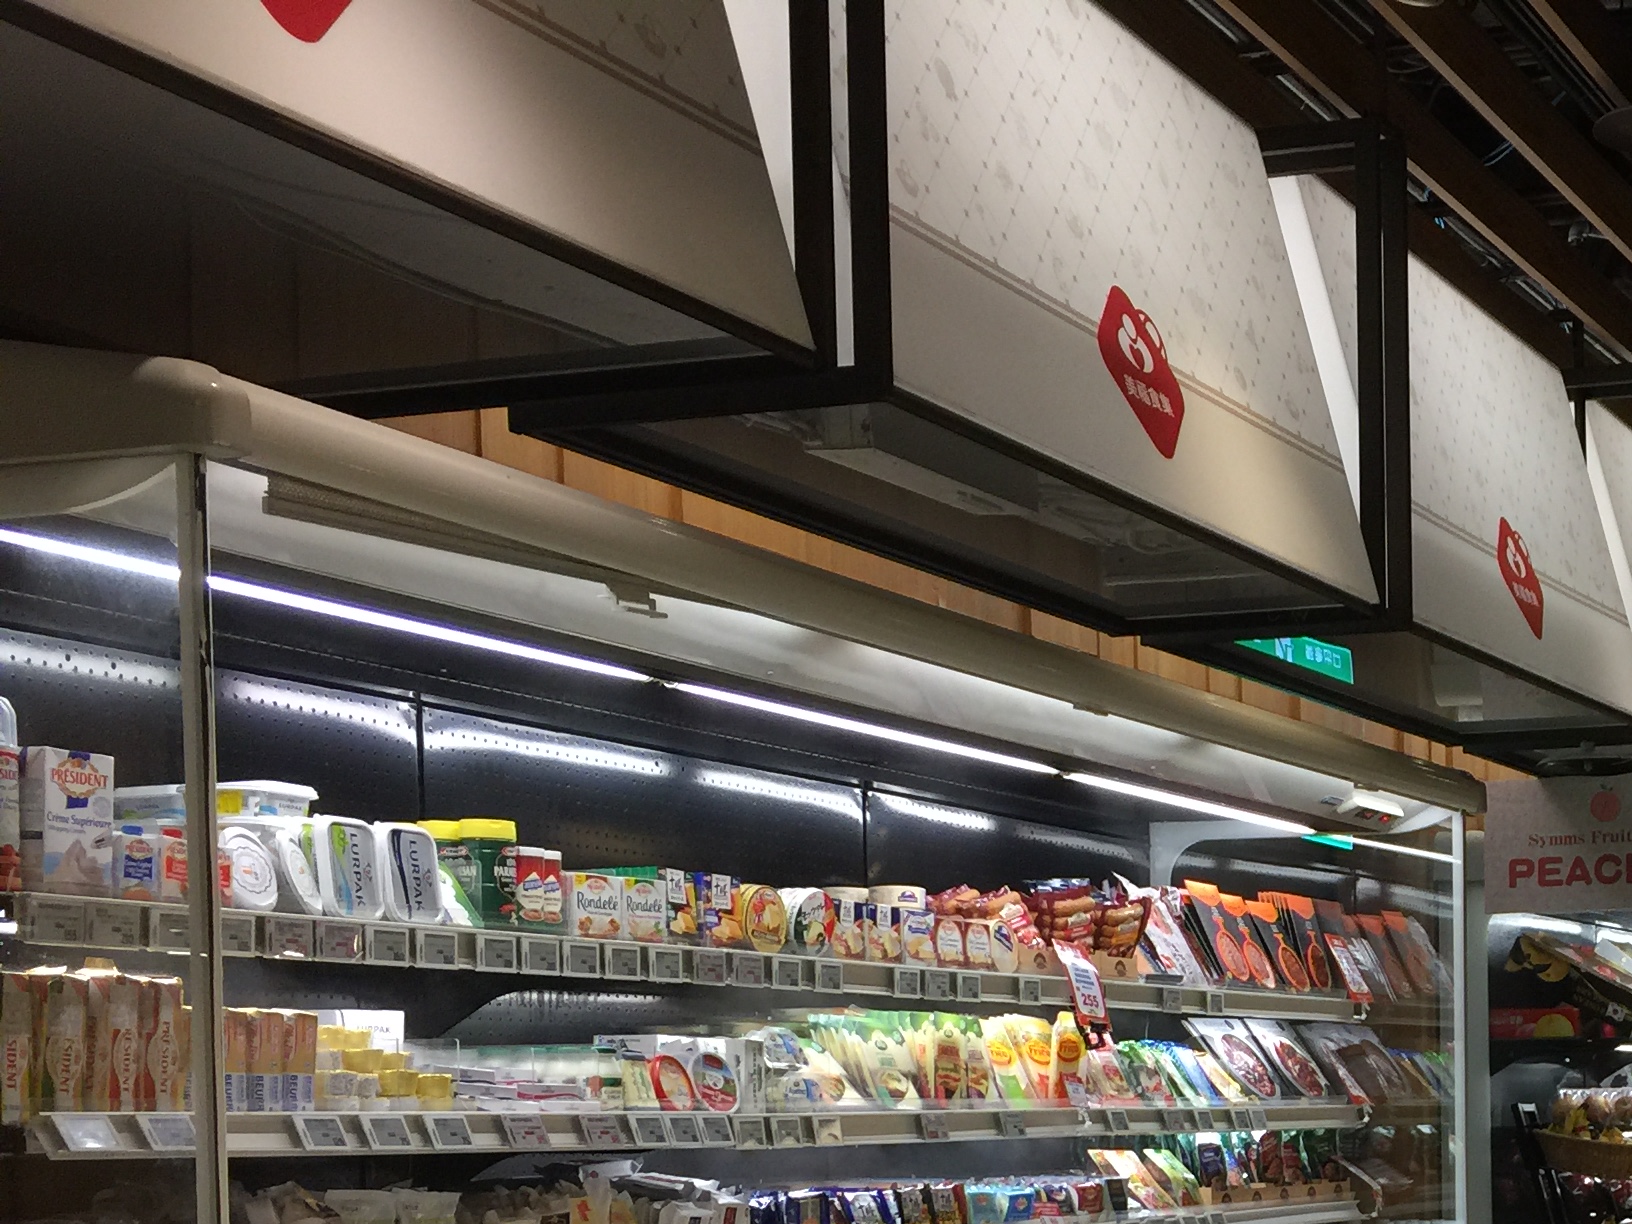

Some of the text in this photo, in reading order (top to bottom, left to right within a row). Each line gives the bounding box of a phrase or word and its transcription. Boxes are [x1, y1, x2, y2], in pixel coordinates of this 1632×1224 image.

[51, 767, 109, 789] PRÉSIDENT
[1591, 829, 1632, 845] Fruit
[349, 832, 367, 908] LURPAK
[408, 839, 425, 911] LURPAK
[576, 891, 619, 911] Rondelé
[626, 895, 663, 913] Rondelé
[1081, 993, 1099, 1009] 255
